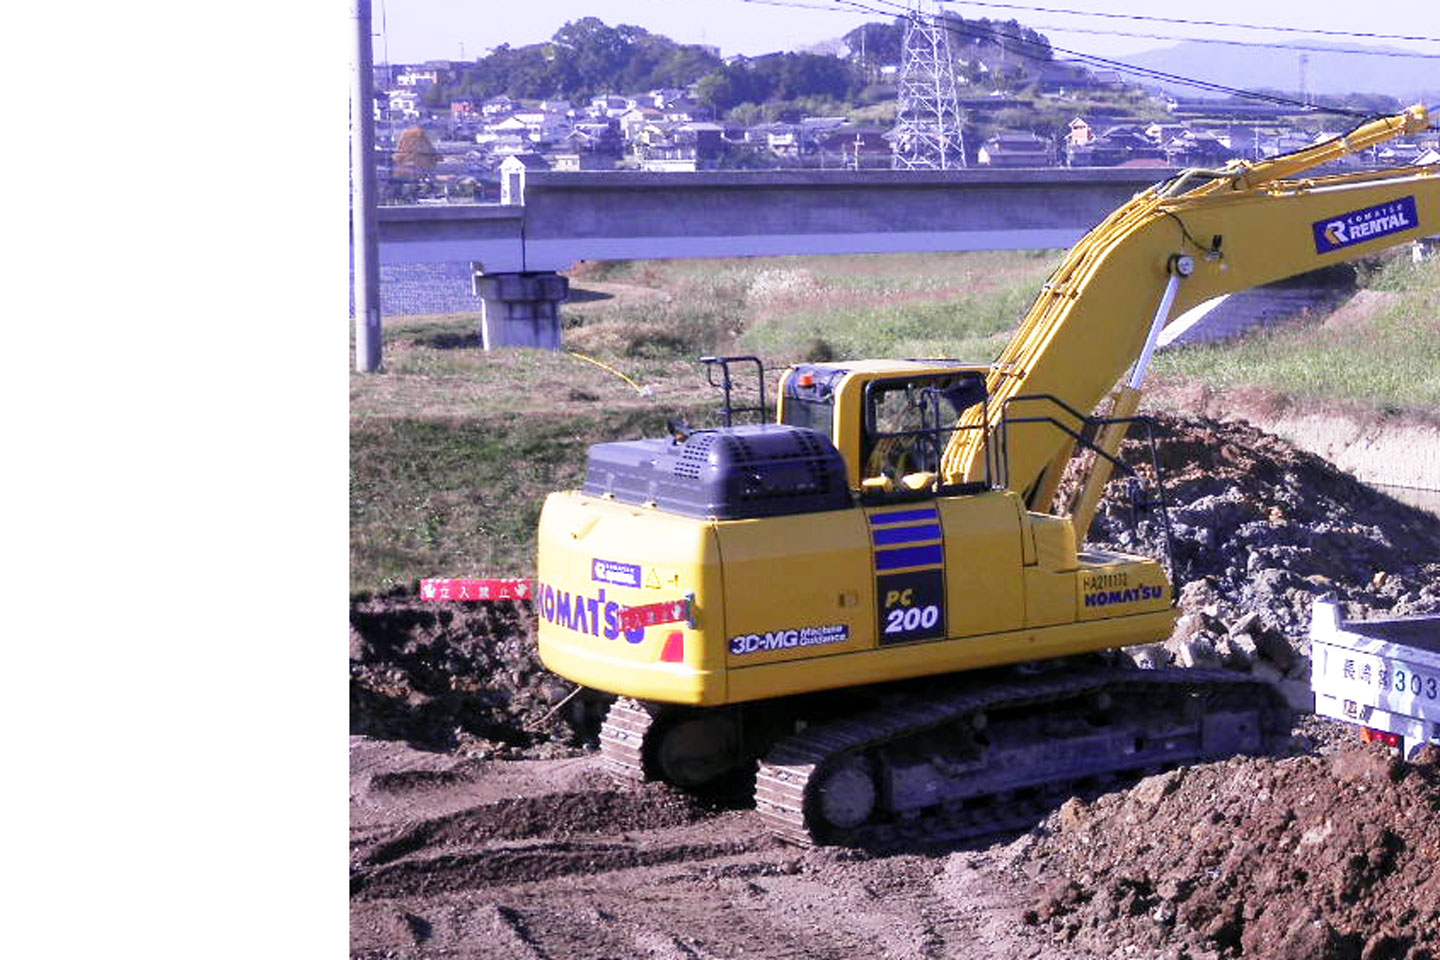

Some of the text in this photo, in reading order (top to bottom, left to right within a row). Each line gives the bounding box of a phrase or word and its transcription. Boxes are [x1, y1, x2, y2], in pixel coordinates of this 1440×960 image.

[1350, 212, 1410, 240] RENTAL
[885, 588, 913, 608] PC
[1085, 584, 1162, 606] KOMATSU
[884, 605, 939, 633] 200
[731, 630, 798, 655] 3D-MG
